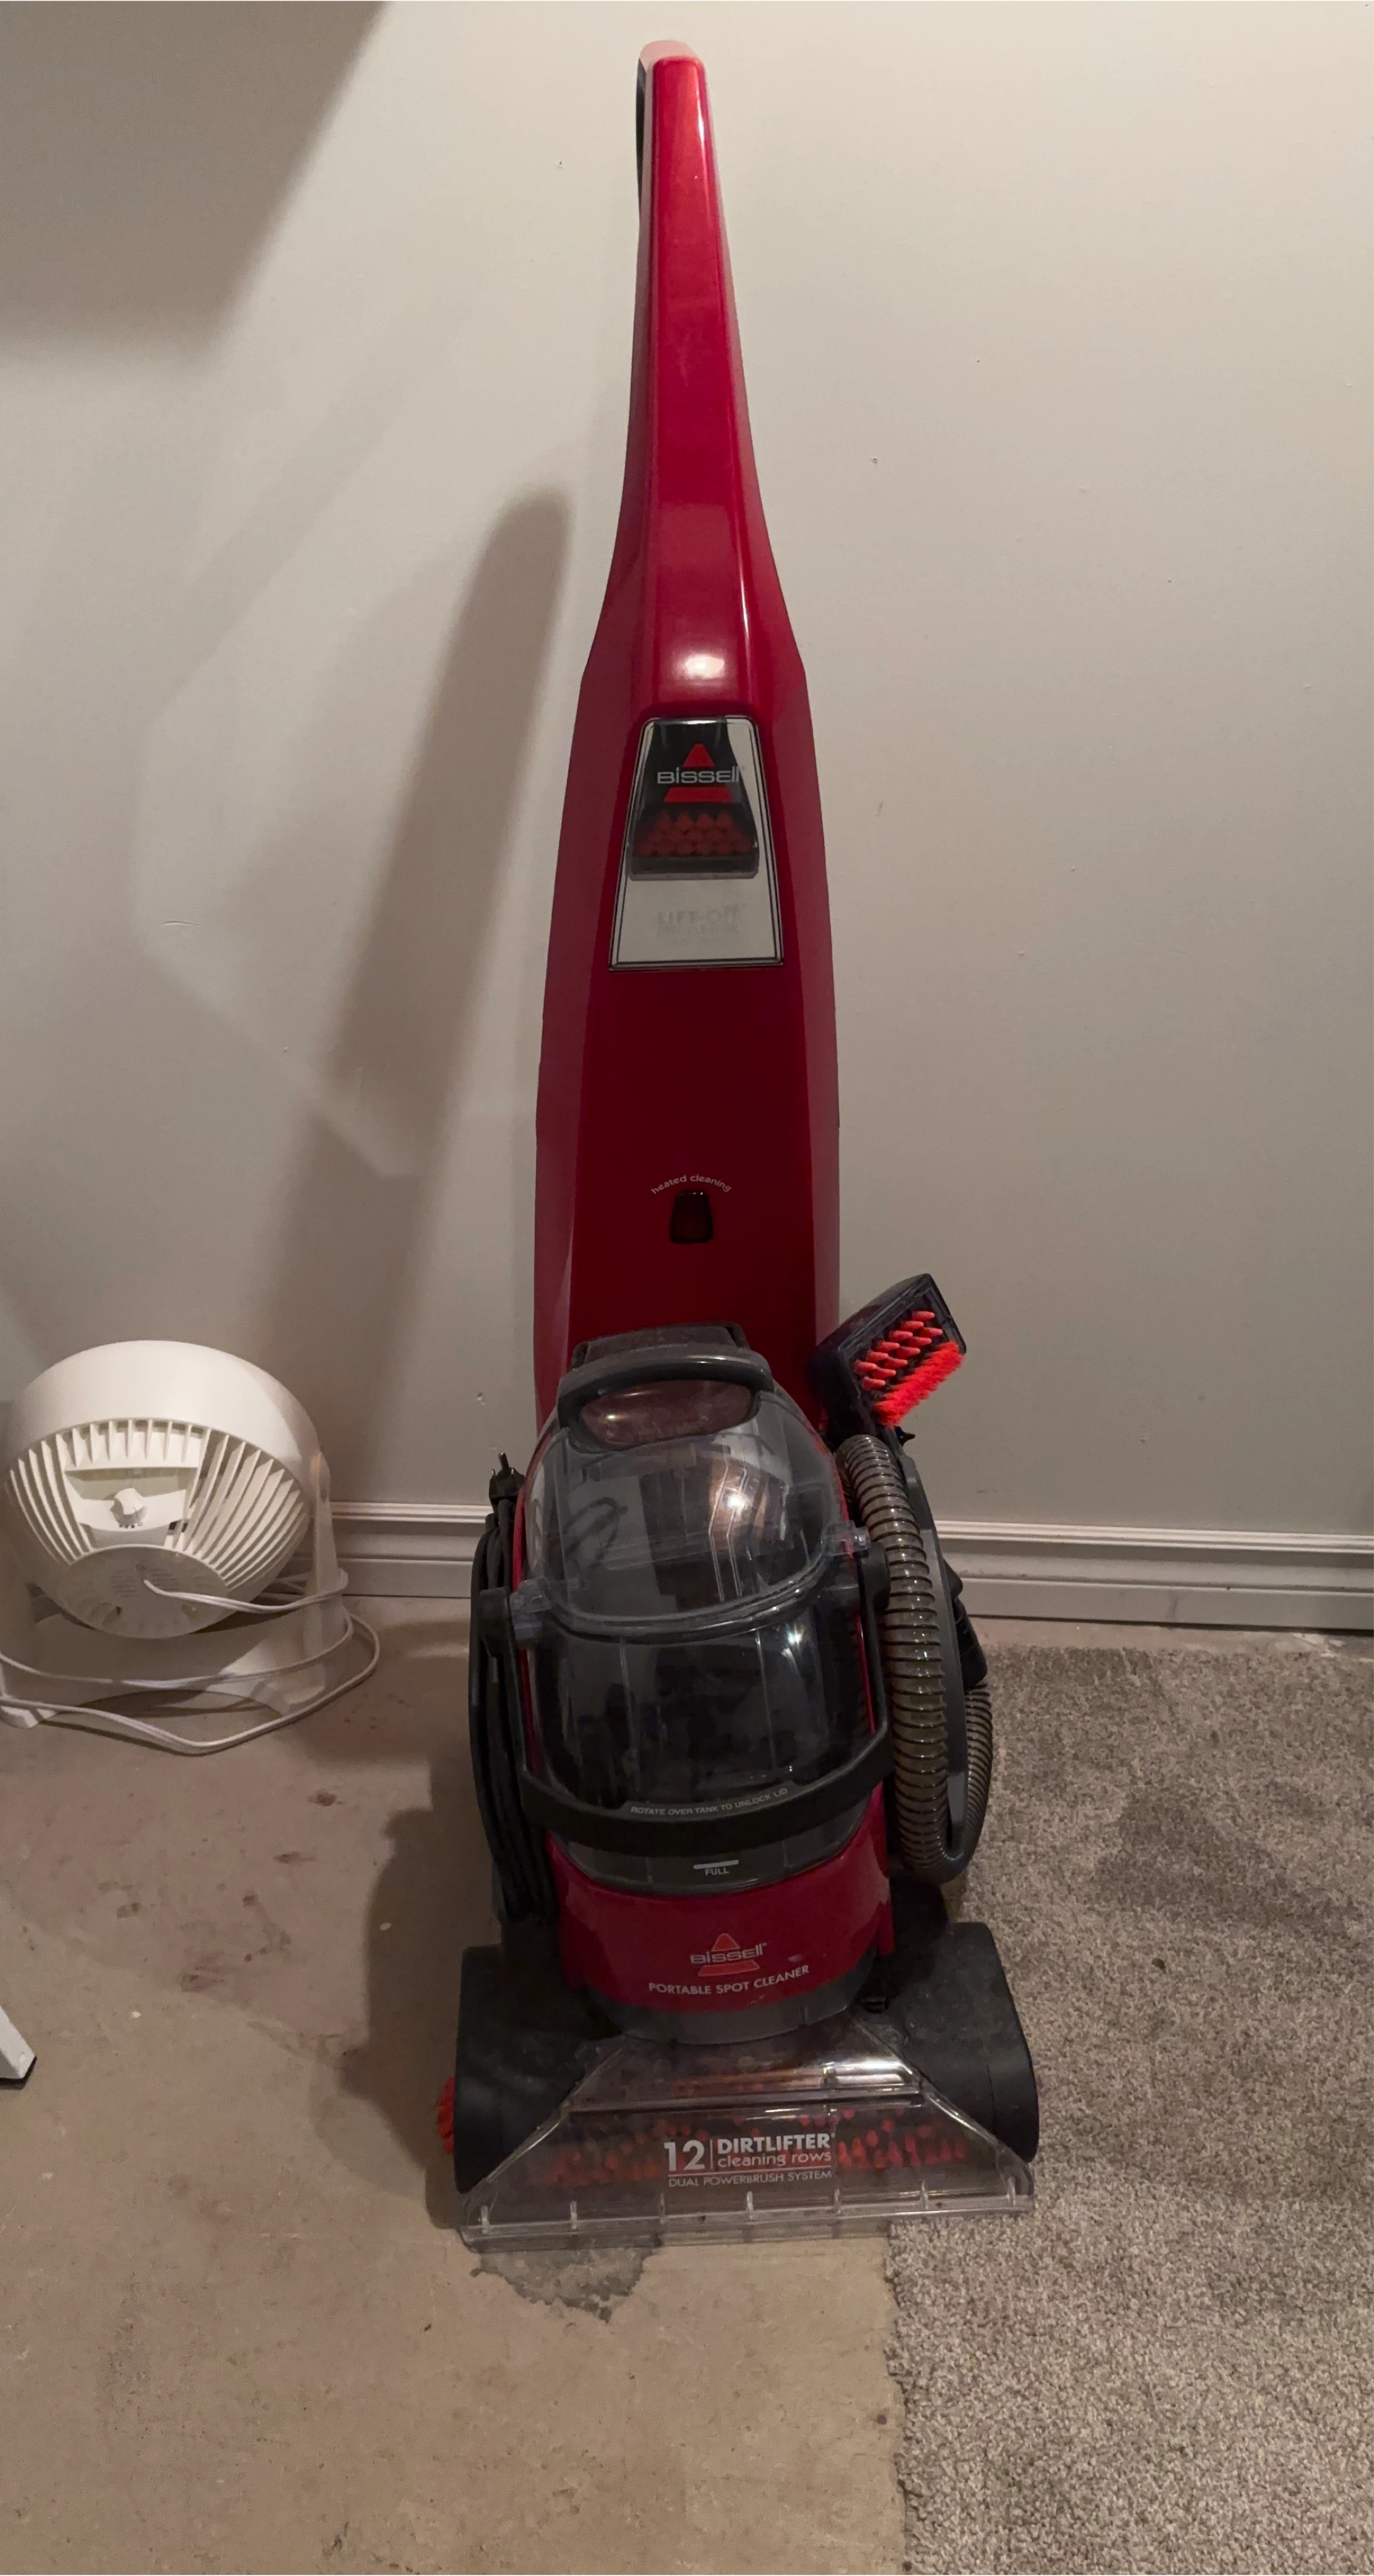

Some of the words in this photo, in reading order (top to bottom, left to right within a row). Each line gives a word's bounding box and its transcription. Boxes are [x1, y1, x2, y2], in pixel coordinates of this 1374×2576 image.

[651, 1175, 687, 1194] heated
[690, 1174, 732, 1193] cleaning
[630, 1806, 666, 1815] ROTATE
[695, 1806, 718, 1814] TANK
[735, 1794, 772, 1809] UNLOCK
[773, 1788, 788, 1797] LID
[705, 1867, 730, 1876] FULL
[649, 1982, 711, 1995] PORTABLE
[716, 1981, 750, 1994] SPOT
[753, 1965, 809, 1989] CLEANER
[664, 2140, 705, 2171] 12
[717, 2133, 831, 2154] DIRTLIFTER
[717, 2153, 786, 2168] cleaning
[791, 2151, 832, 2163] rows
[669, 2177, 700, 2187] DUAL
[703, 2172, 784, 2186] POWERBRUSH
[788, 2170, 833, 2181] SYSTEM
